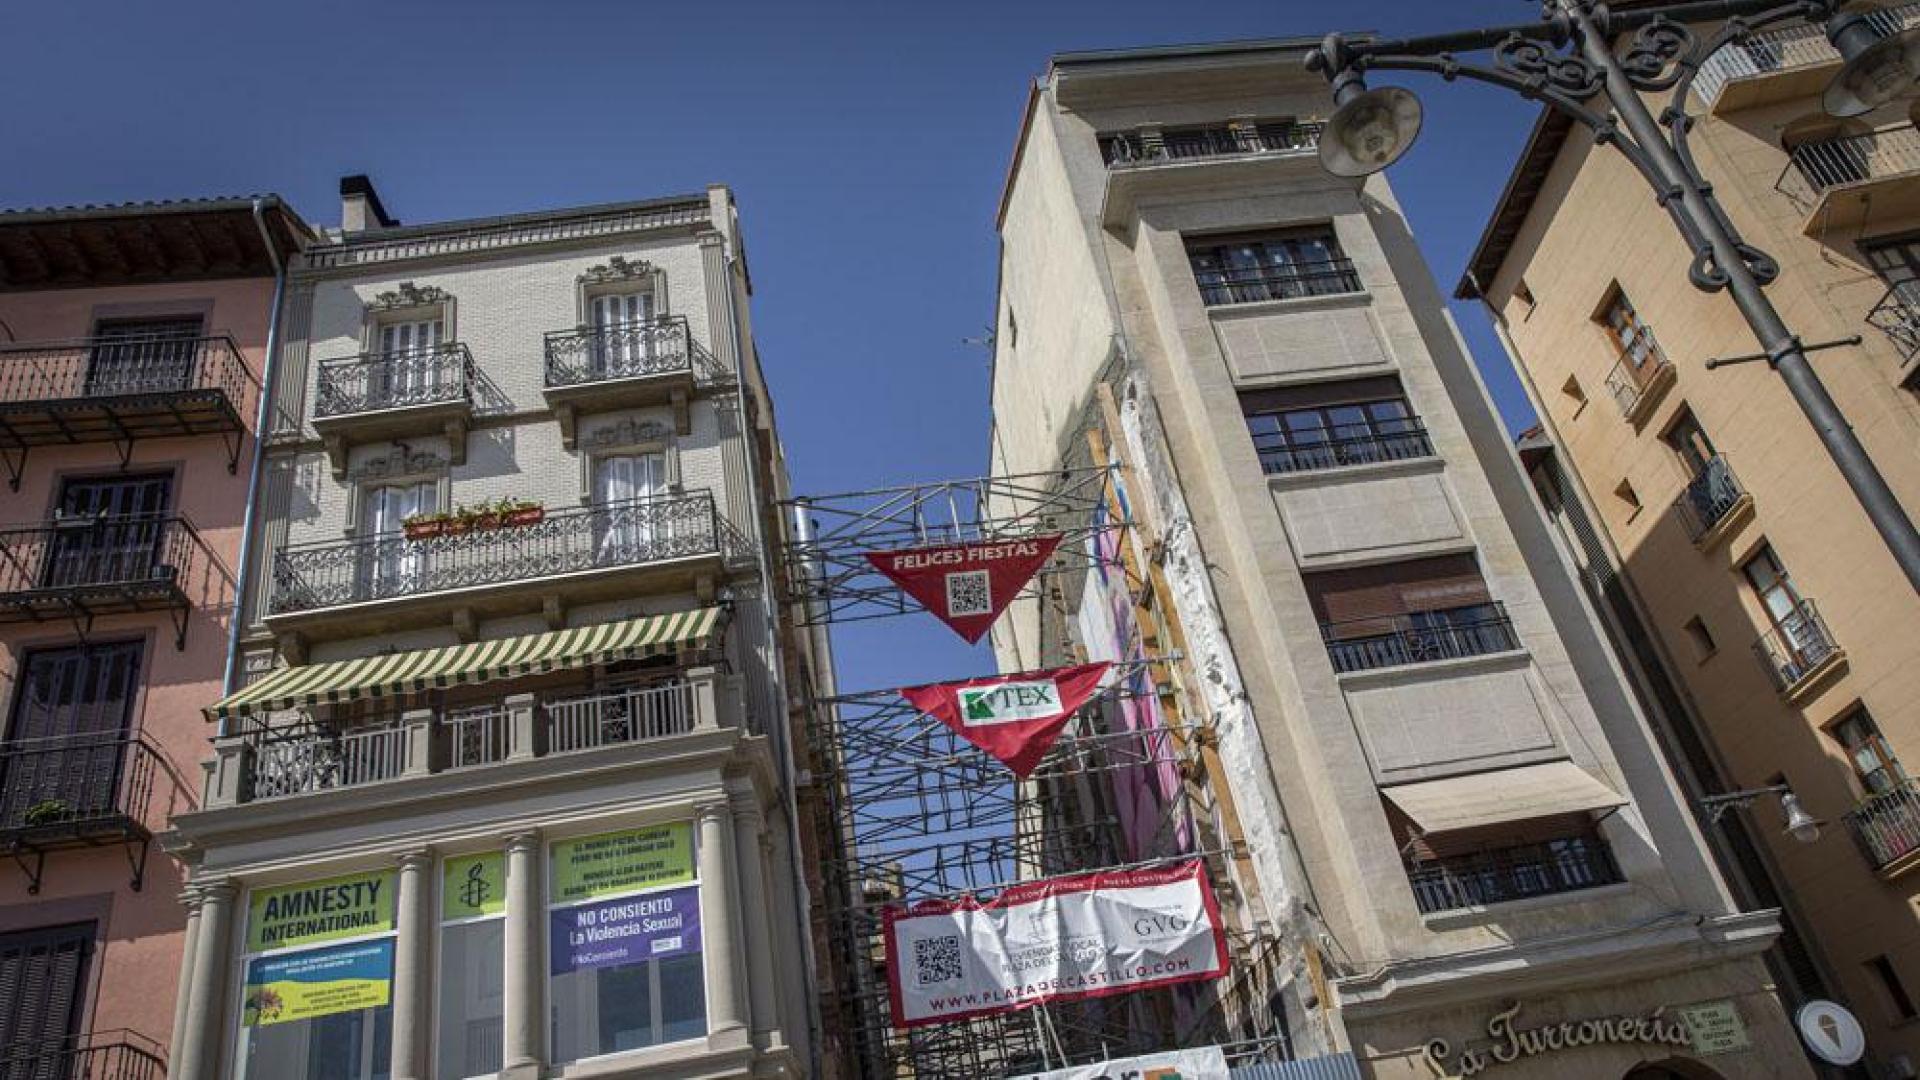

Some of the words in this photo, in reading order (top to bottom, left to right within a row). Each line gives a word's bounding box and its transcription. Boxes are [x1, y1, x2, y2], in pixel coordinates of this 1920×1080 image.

[893, 547, 963, 570] FELICES
[967, 541, 1039, 562] FIESTAS
[264, 879, 382, 923] AMNESTY
[578, 910, 596, 927] NO
[600, 897, 674, 923] CONSIENTO
[261, 910, 379, 944] INTERNATIONAL
[569, 930, 584, 946] La
[586, 921, 640, 943] Violencia
[643, 912, 682, 933] Sexual
[1134, 913, 1188, 937] GVG
[929, 957, 1191, 1013] WWW.PLAZADELCASTILLO.COM
[1422, 1037, 1486, 1080] La
[1488, 1000, 1692, 1063] Turronería
